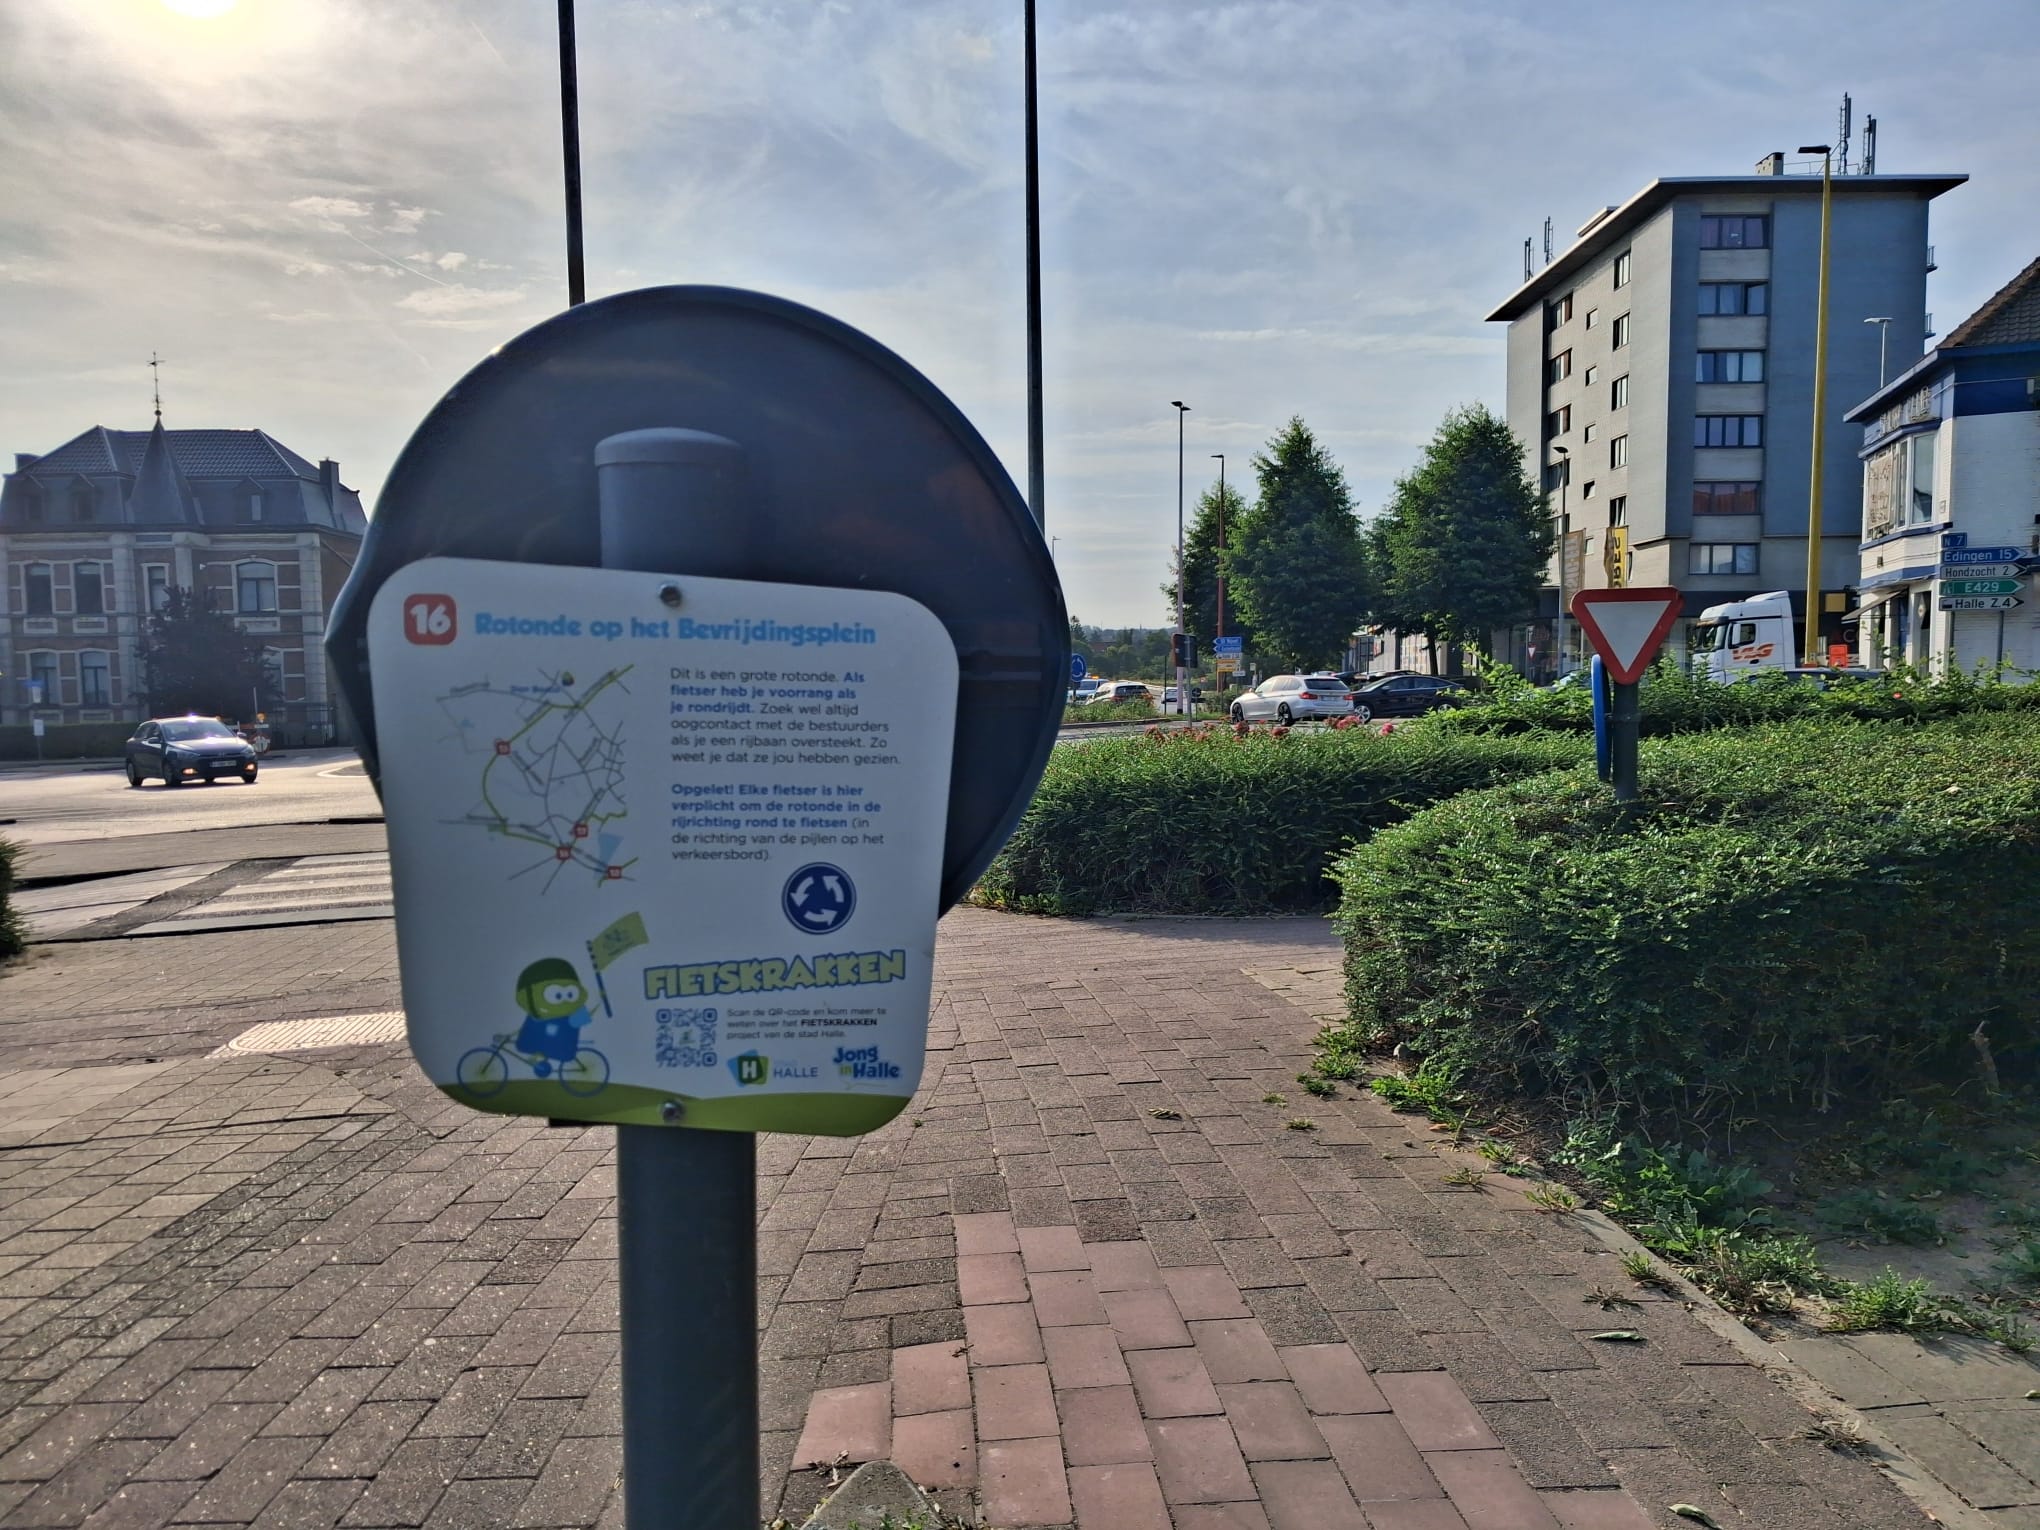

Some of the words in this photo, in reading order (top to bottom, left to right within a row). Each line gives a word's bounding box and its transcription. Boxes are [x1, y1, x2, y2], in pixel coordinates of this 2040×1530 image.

[1956, 536, 1964, 545] 7
[1944, 551, 1992, 563] Edingen
[2000, 548, 2012, 559] 15
[1946, 566, 1996, 577] Hondzocht
[2002, 566, 2009, 576] 2
[1964, 582, 2000, 593] E429
[1955, 599, 1985, 609] Halle
[410, 603, 451, 636] 16
[475, 612, 582, 637] Rotonde
[590, 619, 623, 641] op
[631, 617, 669, 639] het
[678, 617, 876, 647] Bevrijdingsplein
[670, 668, 690, 680] Dit
[695, 668, 706, 680] is
[710, 670, 736, 680] een
[740, 671, 778, 683] grote
[782, 672, 838, 682] rotonde.
[843, 672, 865, 683] Als
[671, 684, 717, 696] fietser
[721, 686, 748, 697] heb
[751, 686, 764, 699] je
[769, 688, 833, 700] voorrang
[837, 688, 856, 699] als
[670, 701, 684, 714] je
[688, 702, 756, 715] rondrijdt.
[760, 702, 794, 714] Zoek
[798, 704, 821, 715] wel
[825, 704, 859, 718] altijd
[671, 720, 752, 731] oogcontact
[756, 720, 782, 731] met
[787, 720, 805, 731] de
[808, 720, 890, 732] bestuurders
[671, 735, 690, 746] als
[694, 735, 706, 748] je
[710, 736, 736, 746] een
[740, 735, 787, 748] rijbaan
[791, 736, 866, 748] oversteekt.
[870, 736, 888, 748] Zo
[672, 752, 705, 762] weet
[709, 752, 722, 764] je
[726, 752, 748, 763] dat
[753, 754, 770, 763] ze
[772, 752, 794, 766] jou
[798, 752, 850, 764] hebben
[854, 754, 900, 766] gezien.
[671, 784, 734, 796] Opgelet!
[738, 784, 769, 796] Elke
[773, 784, 818, 796] fietser
[821, 785, 833, 796] is
[836, 785, 864, 796] hier
[672, 800, 735, 813] verplicht
[739, 802, 762, 812] om
[766, 800, 784, 812] de
[788, 801, 844, 812] rotonde
[847, 801, 860, 812] in
[864, 801, 882, 812] de
[672, 816, 741, 830] rijrichting
[745, 816, 778, 828] rond
[782, 817, 796, 828] te
[800, 817, 848, 828] fietsen
[852, 818, 870, 830] (in
[671, 832, 690, 844] de
[693, 832, 747, 846] richting
[751, 834, 776, 844] van
[779, 833, 797, 844] de
[800, 834, 837, 846] pijlen
[841, 835, 859, 846] op
[863, 834, 885, 844] het
[671, 849, 771, 862] verkeersbord).
[644, 950, 906, 1000] FIETSKRAKKEN
[727, 1008, 750, 1016] Scan
[752, 1008, 765, 1016] de
[768, 1008, 811, 1016] QR-code
[814, 1008, 825, 1016] en
[826, 1007, 848, 1016] kom
[850, 1008, 874, 1016] meer
[782, 1020, 798, 1028] het
[800, 1018, 878, 1027] FIETSKRAKKEN
[726, 1032, 760, 1040] project
[798, 1030, 819, 1038] stad
[833, 1046, 879, 1064] Jong
[742, 1060, 758, 1079] H
[774, 1066, 819, 1079] HALLE
[840, 1064, 852, 1076] in
[853, 1062, 901, 1079] Halle
